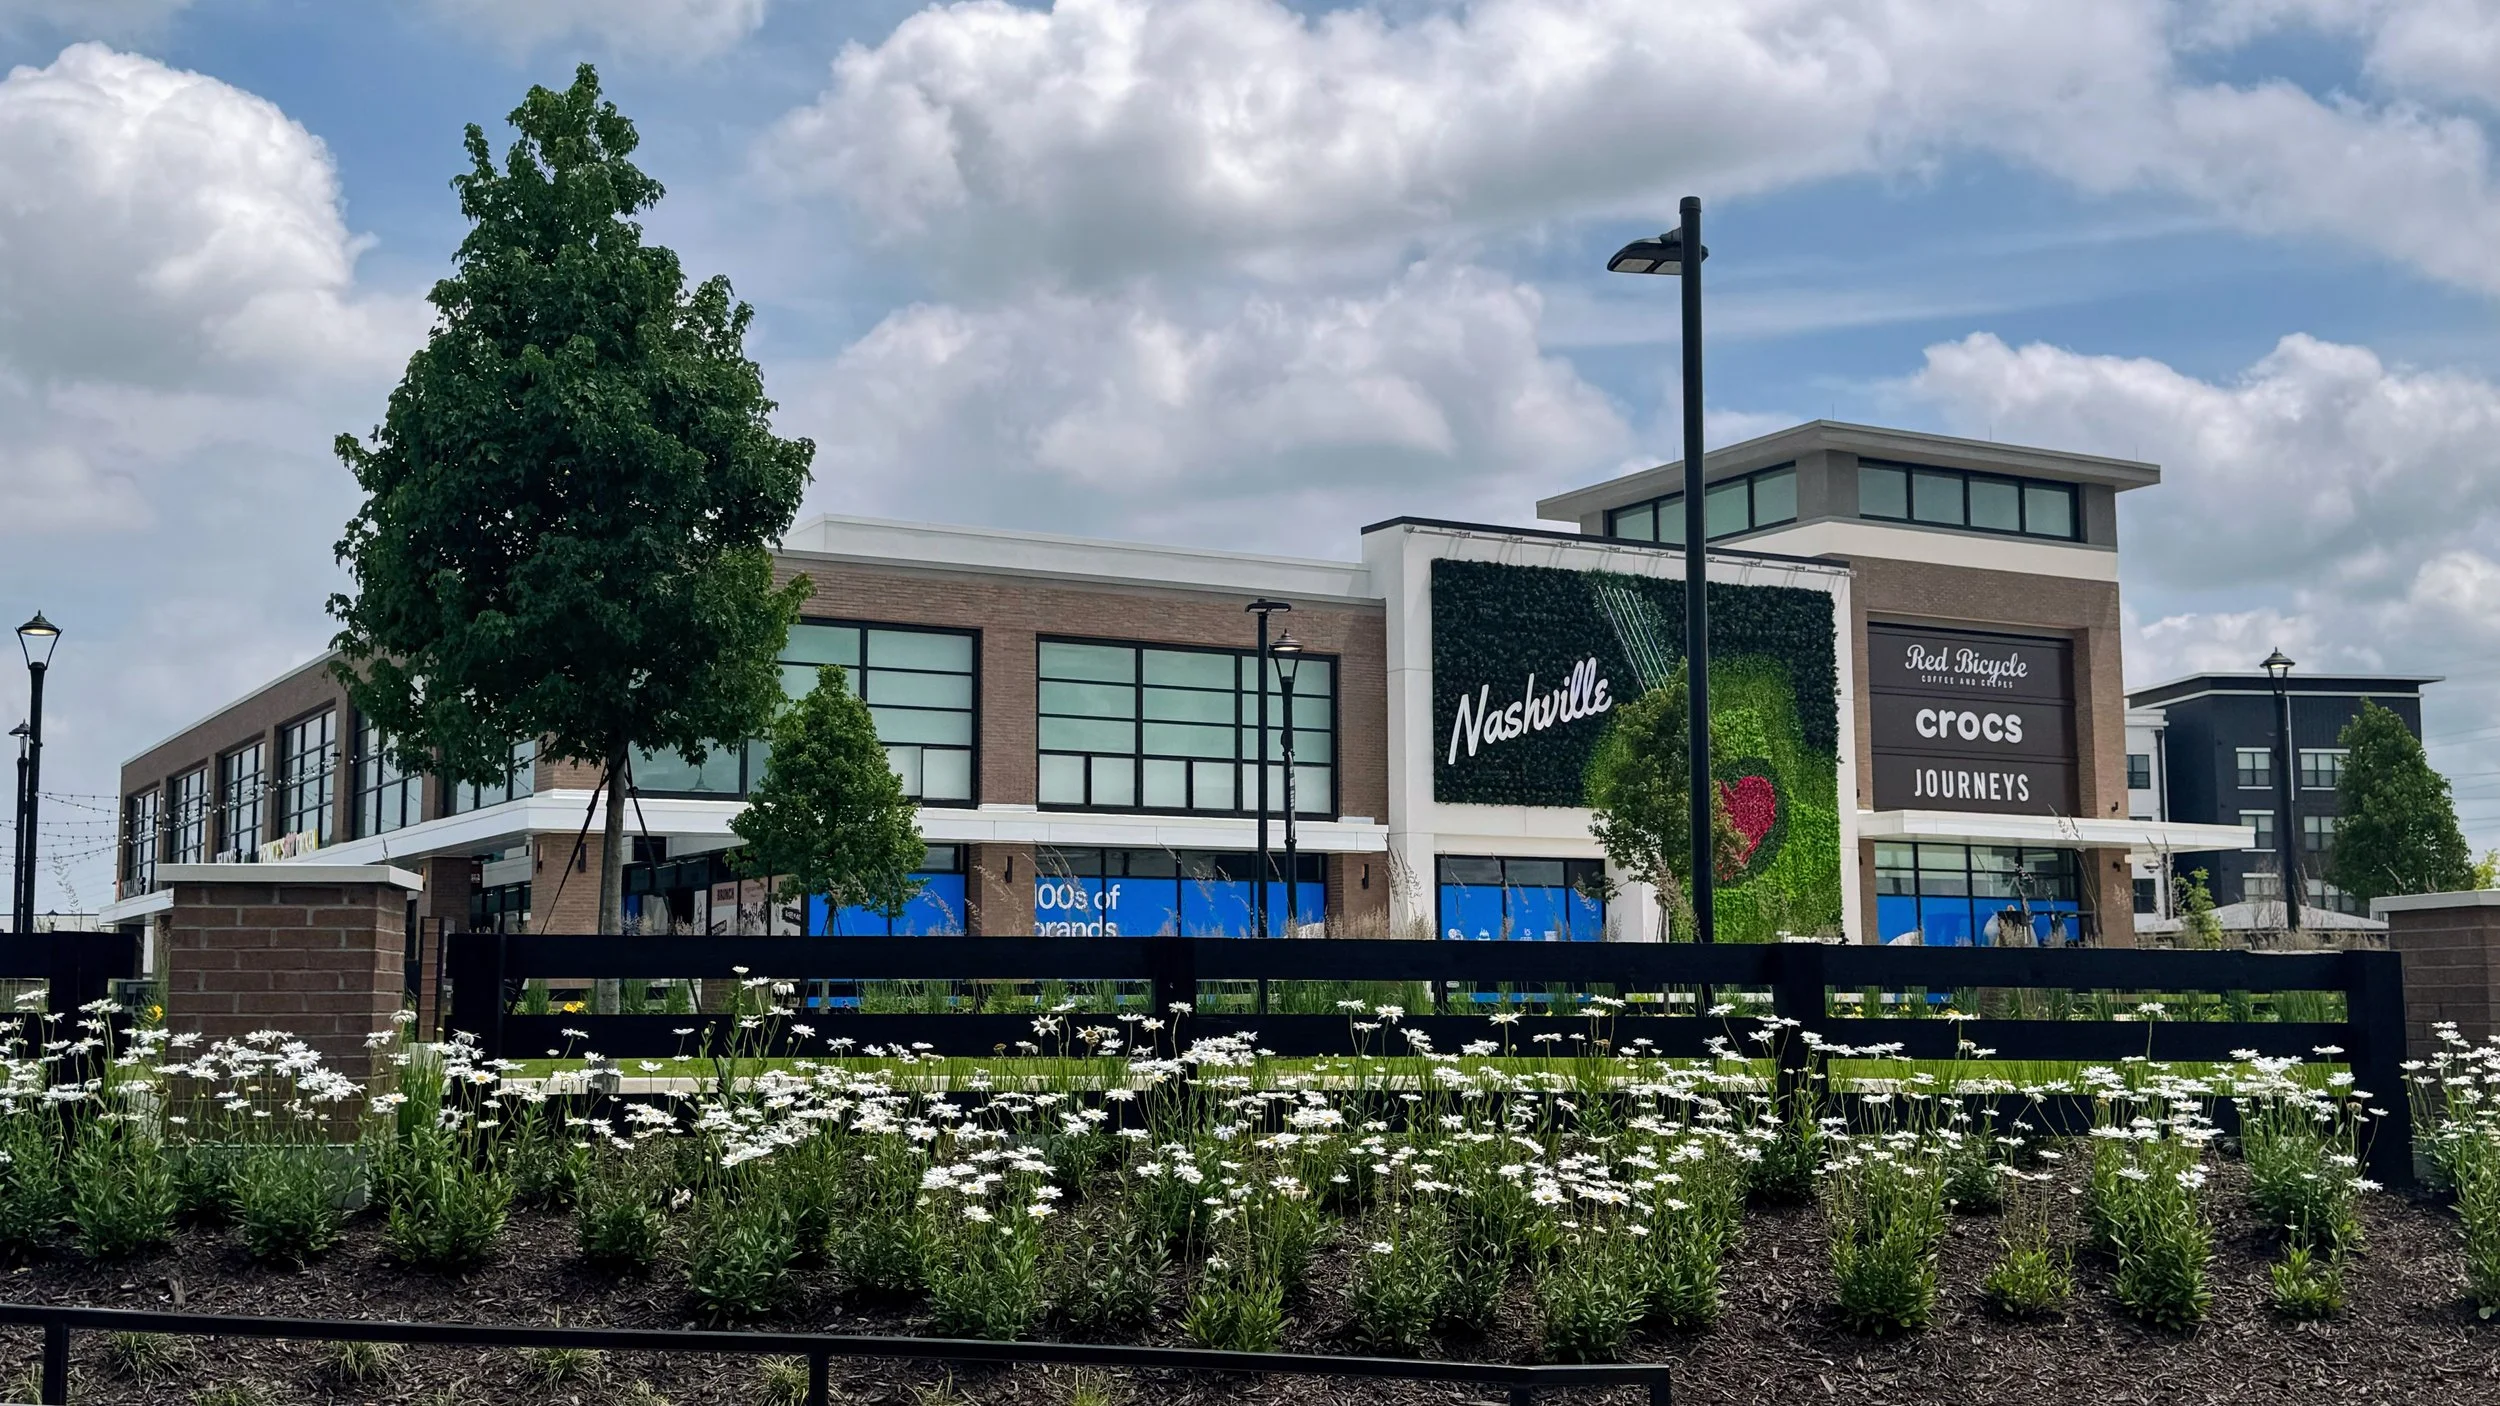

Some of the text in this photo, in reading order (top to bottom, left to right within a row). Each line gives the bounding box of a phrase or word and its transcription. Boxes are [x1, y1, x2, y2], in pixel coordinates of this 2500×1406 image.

[1905, 644, 2028, 685] Red Bicycle
[1921, 674, 1955, 685] COFFEE
[1959, 678, 1976, 686] AND
[1448, 656, 1613, 765] Nashville
[1915, 708, 2023, 744] crocs
[1914, 768, 2030, 802] JOURNEYS
[1094, 884, 1121, 910] of
